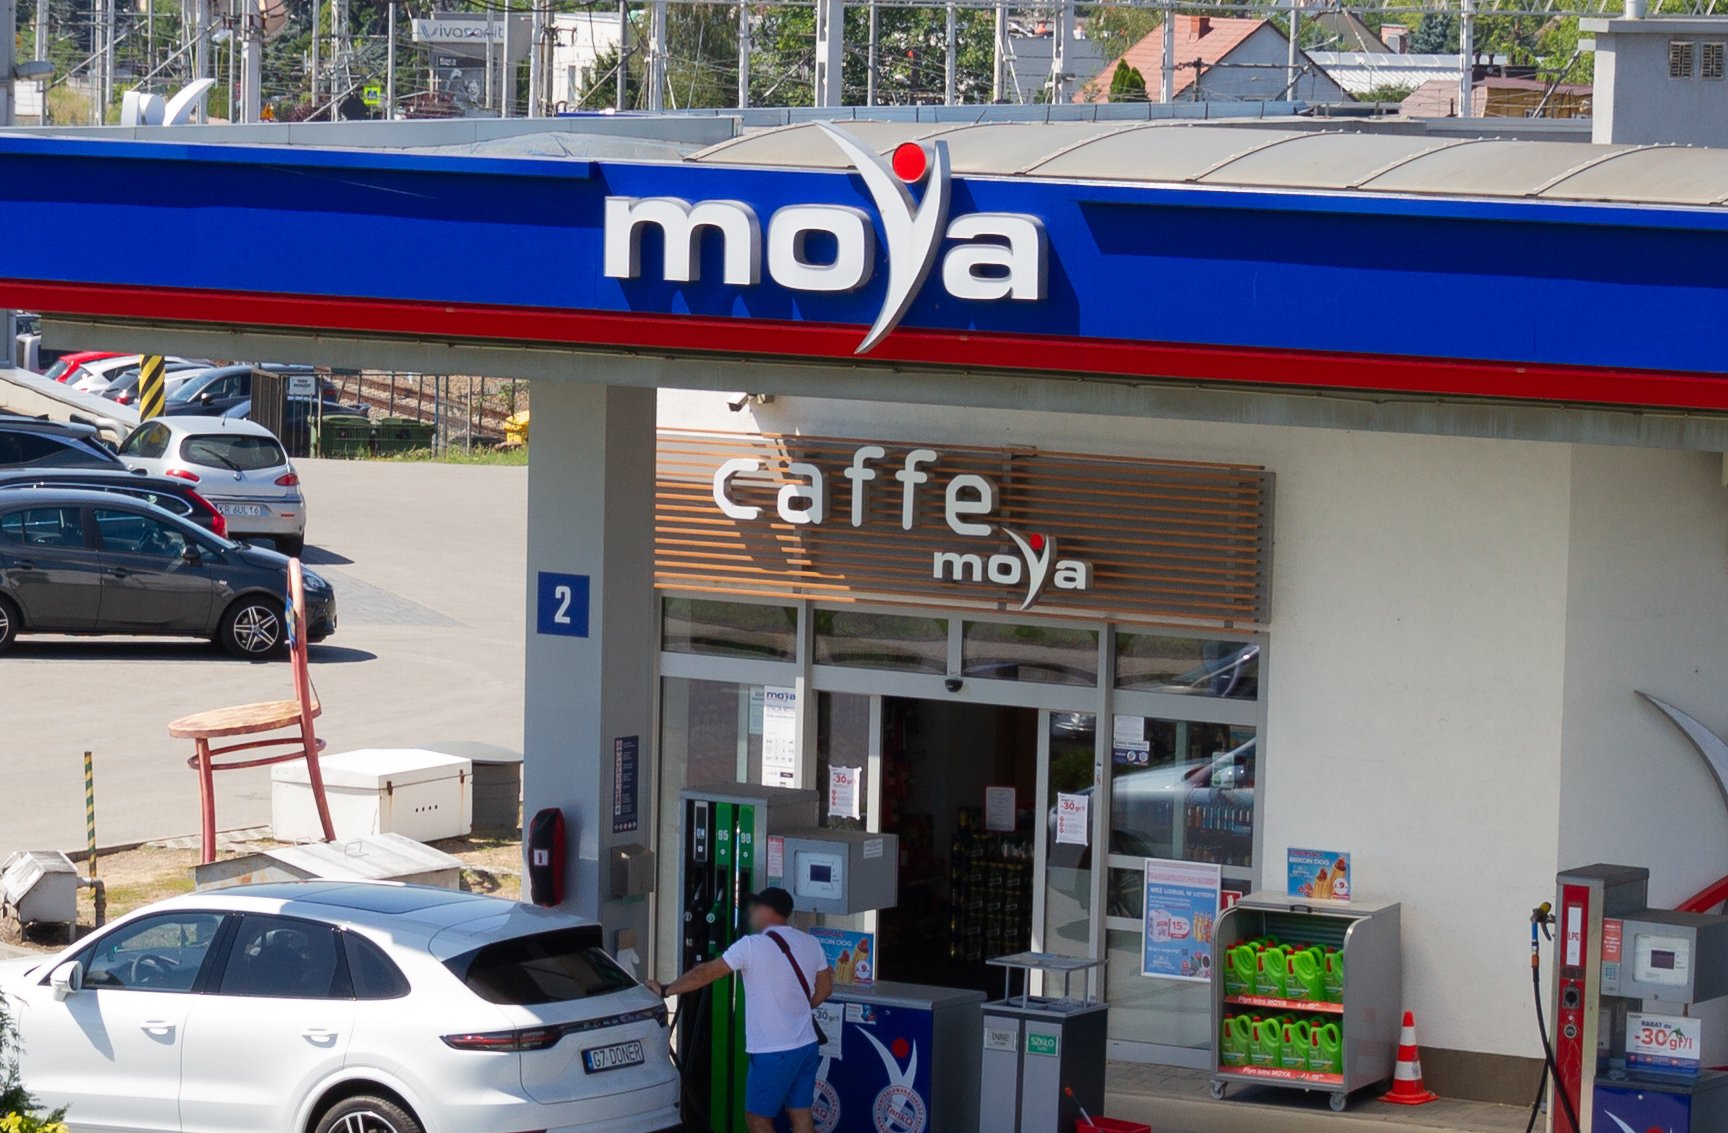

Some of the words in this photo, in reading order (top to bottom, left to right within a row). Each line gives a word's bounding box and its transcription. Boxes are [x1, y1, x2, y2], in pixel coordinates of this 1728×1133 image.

[712, 445, 999, 537] caffe
[932, 526, 1092, 611] moya
[554, 585, 572, 624] 2
[717, 829, 729, 841] 95
[741, 832, 752, 844] 98
[837, 939, 852, 947] DOG
[1568, 931, 1580, 942] LPG
[1634, 1028, 1668, 1046] -30
[1669, 1036, 1692, 1051] gr/l
[592, 1051, 606, 1068] G7
[610, 1044, 642, 1065] DONER
[884, 1102, 915, 1128] TankQ
